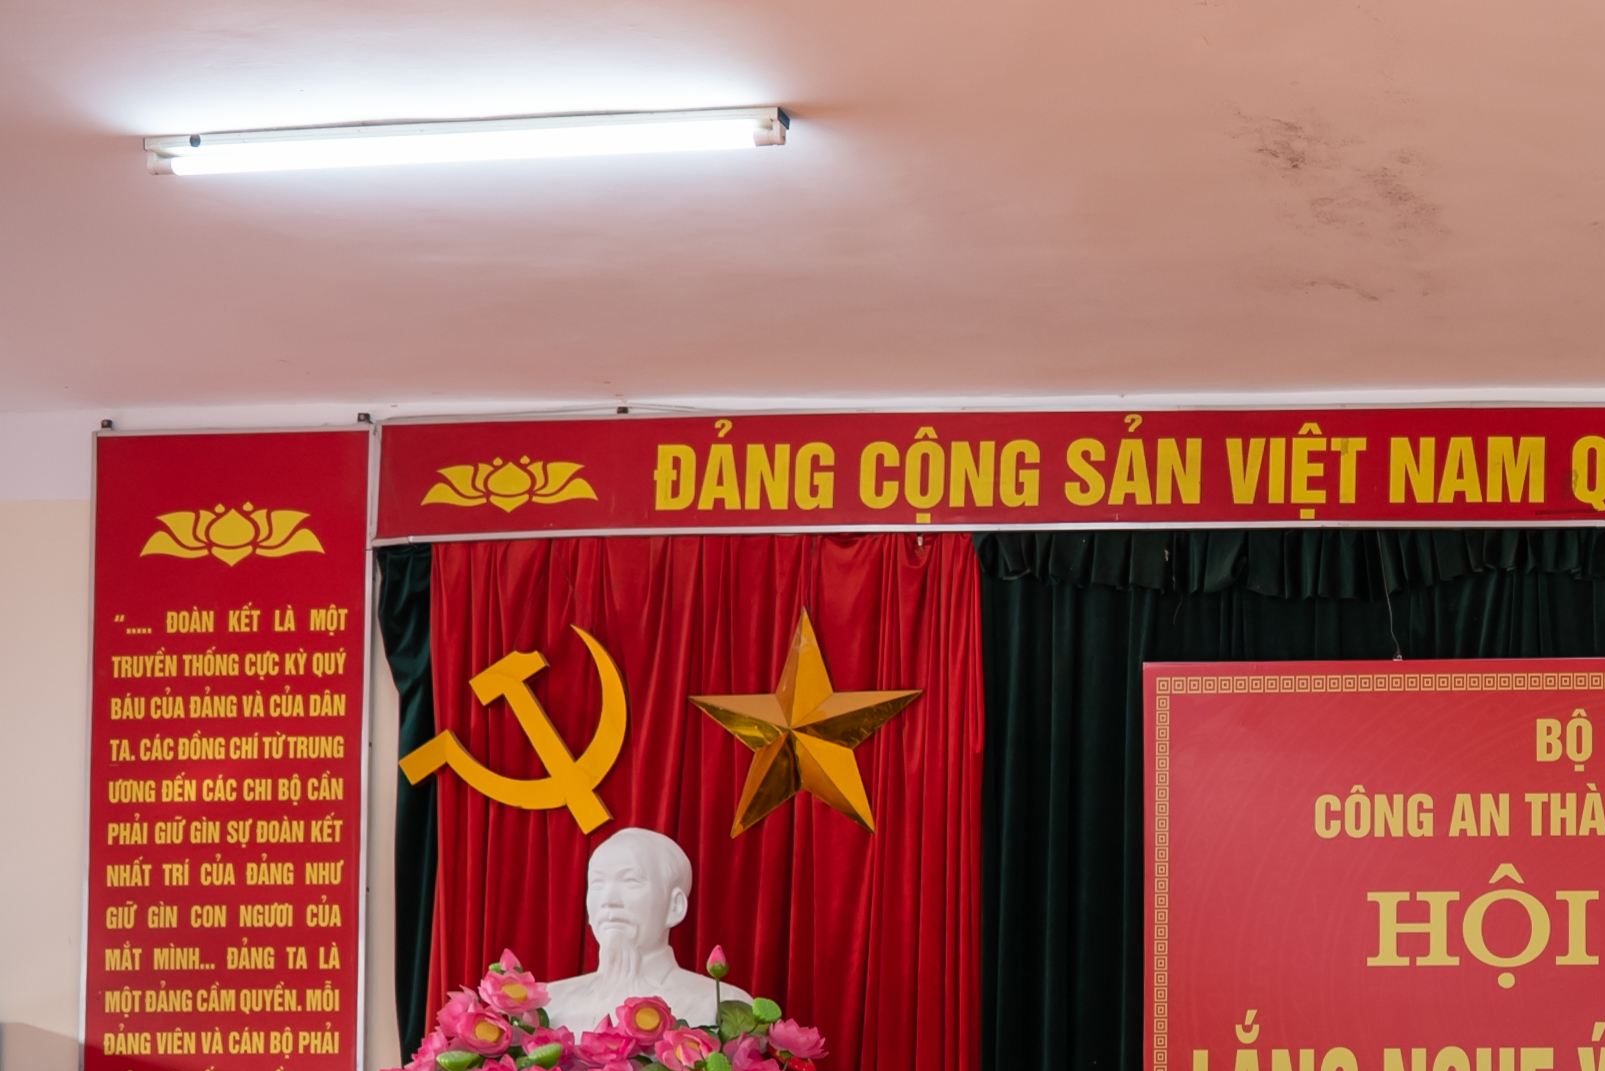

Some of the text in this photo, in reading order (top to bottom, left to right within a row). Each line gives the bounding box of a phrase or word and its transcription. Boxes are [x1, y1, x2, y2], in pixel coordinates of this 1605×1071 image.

[653, 419, 835, 511] ĐẢNG
[859, 426, 1041, 521] CỘNG
[1064, 413, 1202, 506] SẢN
[1225, 422, 1367, 520] VIỆT
[1389, 436, 1546, 503] NAM
[166, 602, 348, 636] ĐOÀN KẾT LÀ MỘT
[111, 646, 347, 681] TRUYỀN THỐNG CỰC KỲ QUÝ
[110, 685, 346, 720] BÁU CỦA ĐẢNG VÀ CỦA DÂN
[109, 730, 345, 762] TA. CÁC ĐỒNG CHÍ TỪ TRUNG
[1536, 708, 1593, 772] BỘ
[1314, 784, 1434, 839] CÔNG
[1448, 792, 1510, 837] AN
[107, 812, 344, 848] PHẢI GIỮ GÌN SỰ ĐOÀN KẾT
[106, 852, 345, 887] NHẤT TRÍ CỦA ĐẢNG NHƯ
[1366, 862, 1600, 989] HỘI
[104, 937, 341, 972] MẮT MÌNH... ĐẢNG TA LÀ
[104, 980, 340, 1018] MỘT ĐẢNG CẦM QUYỀN. MỖI
[103, 1021, 340, 1060] ĐẢNG VIÊN VÀ CÁN BỘ PHẢI
